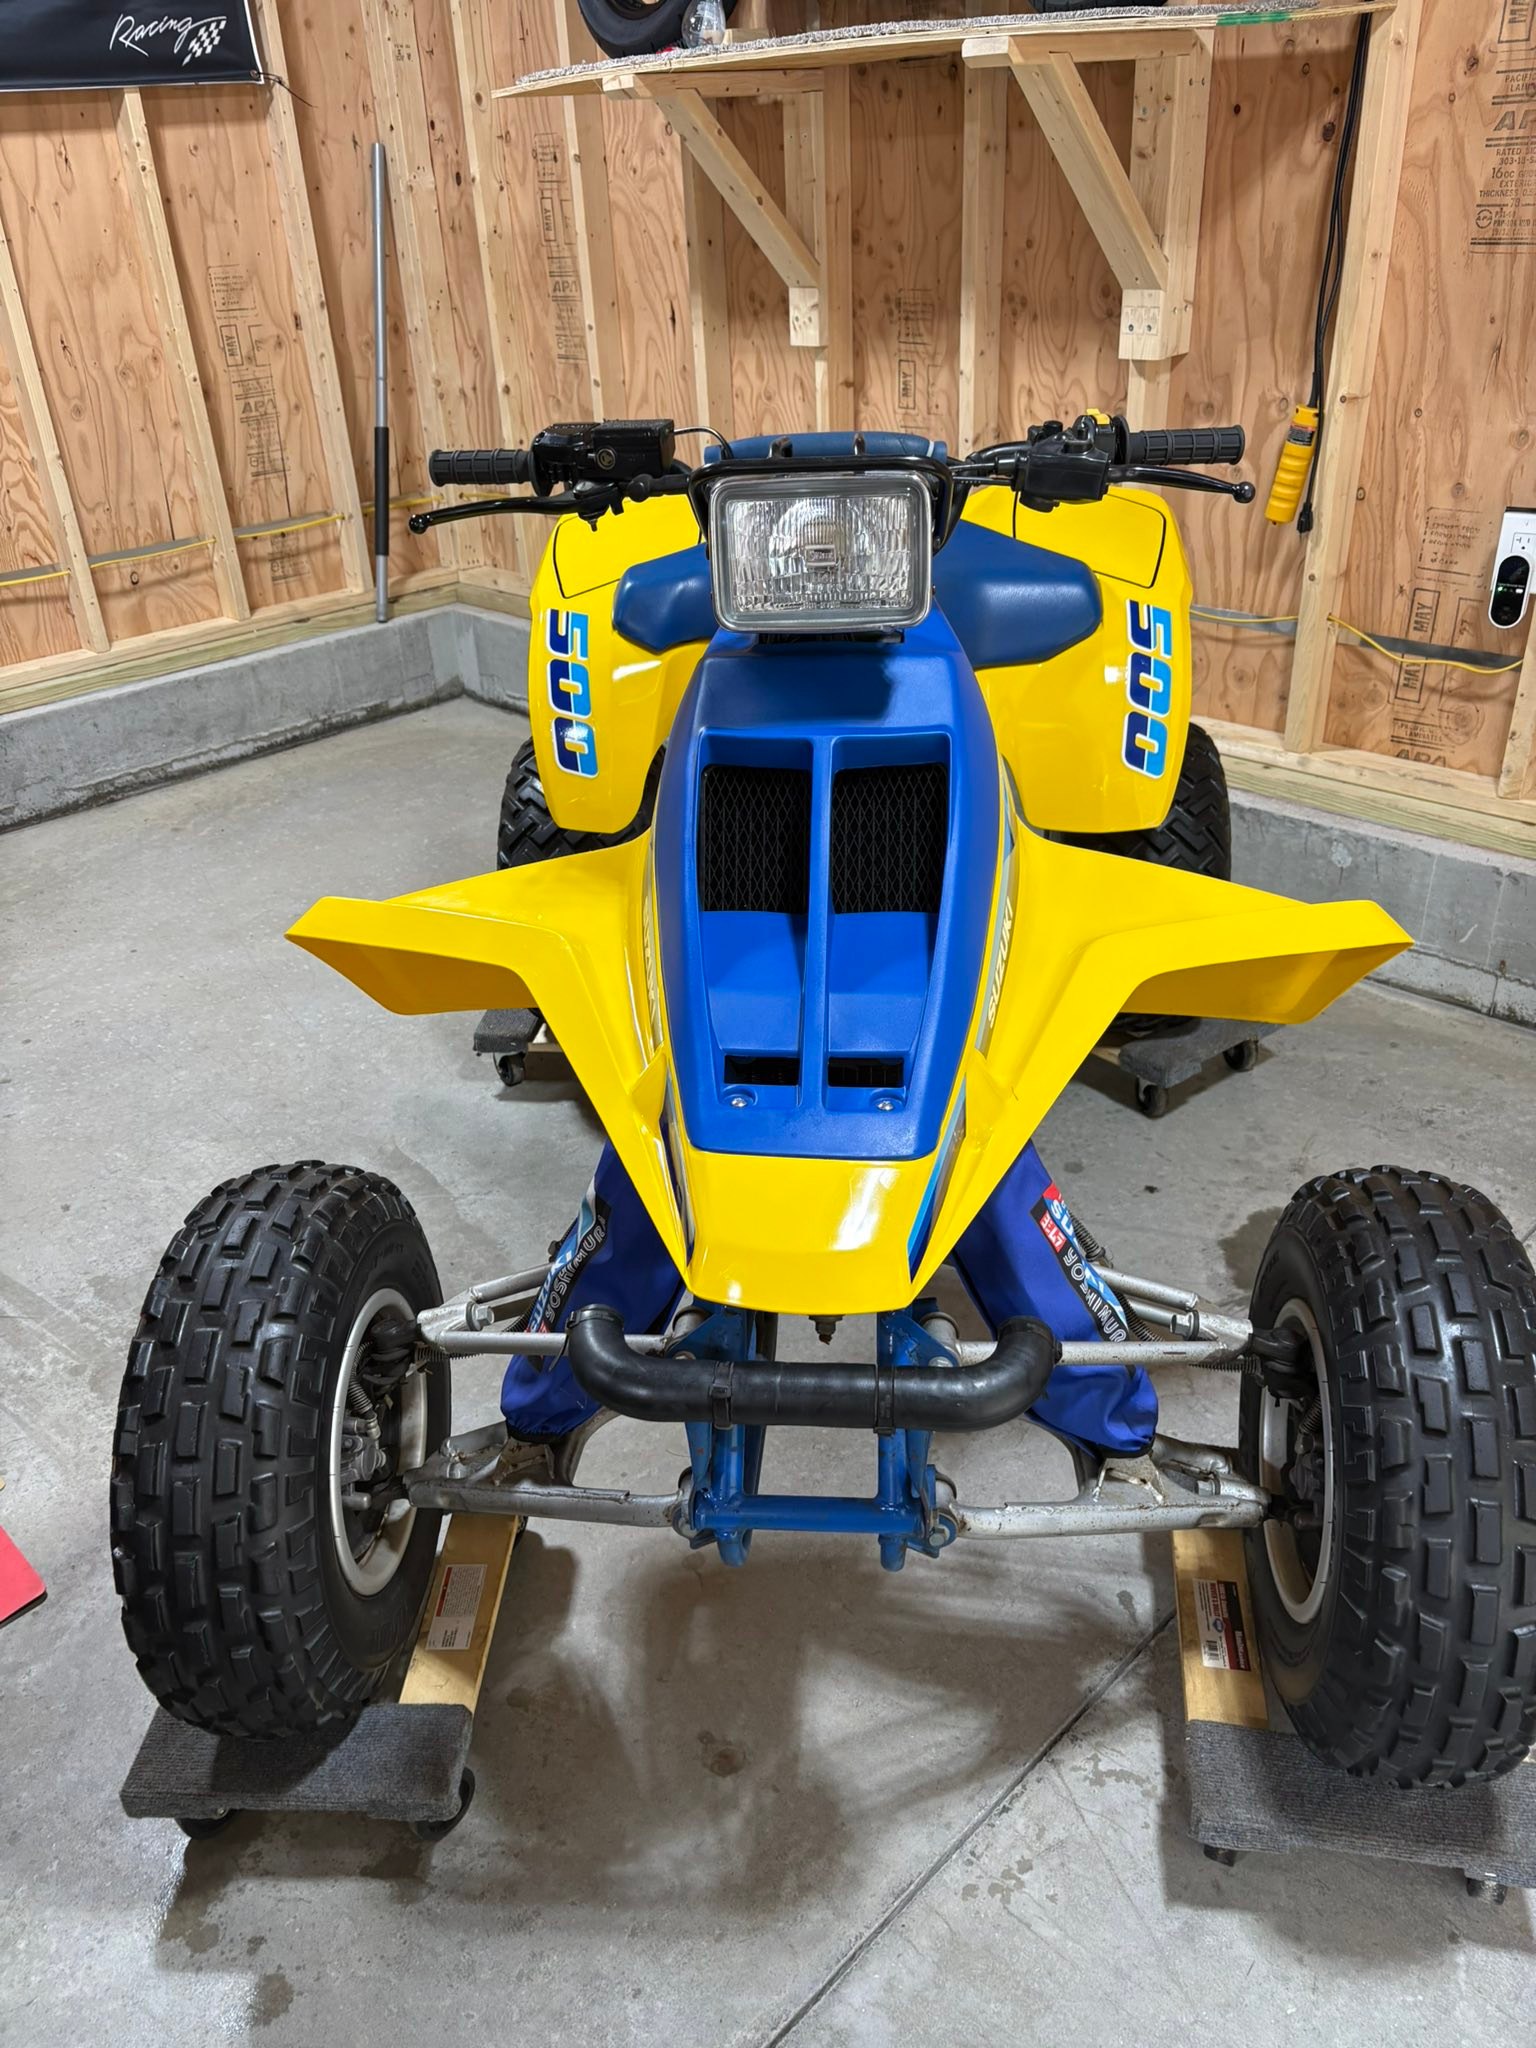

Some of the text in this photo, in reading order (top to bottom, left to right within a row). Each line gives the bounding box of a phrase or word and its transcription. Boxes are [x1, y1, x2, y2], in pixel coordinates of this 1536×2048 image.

[108, 13, 227, 57] Racing
[1496, 147, 1522, 156] RATED
[544, 208, 553, 232] MAY
[552, 281, 578, 294] APA
[225, 335, 239, 357] MAY
[902, 371, 913, 398] MAY
[241, 399, 277, 415] APA
[1413, 602, 1433, 633] MAY
[546, 608, 599, 779] 500
[1121, 598, 1172, 779] 500
[987, 896, 1014, 1029] SUZUKI
[1063, 1247, 1128, 1342] YOSHIMUR
